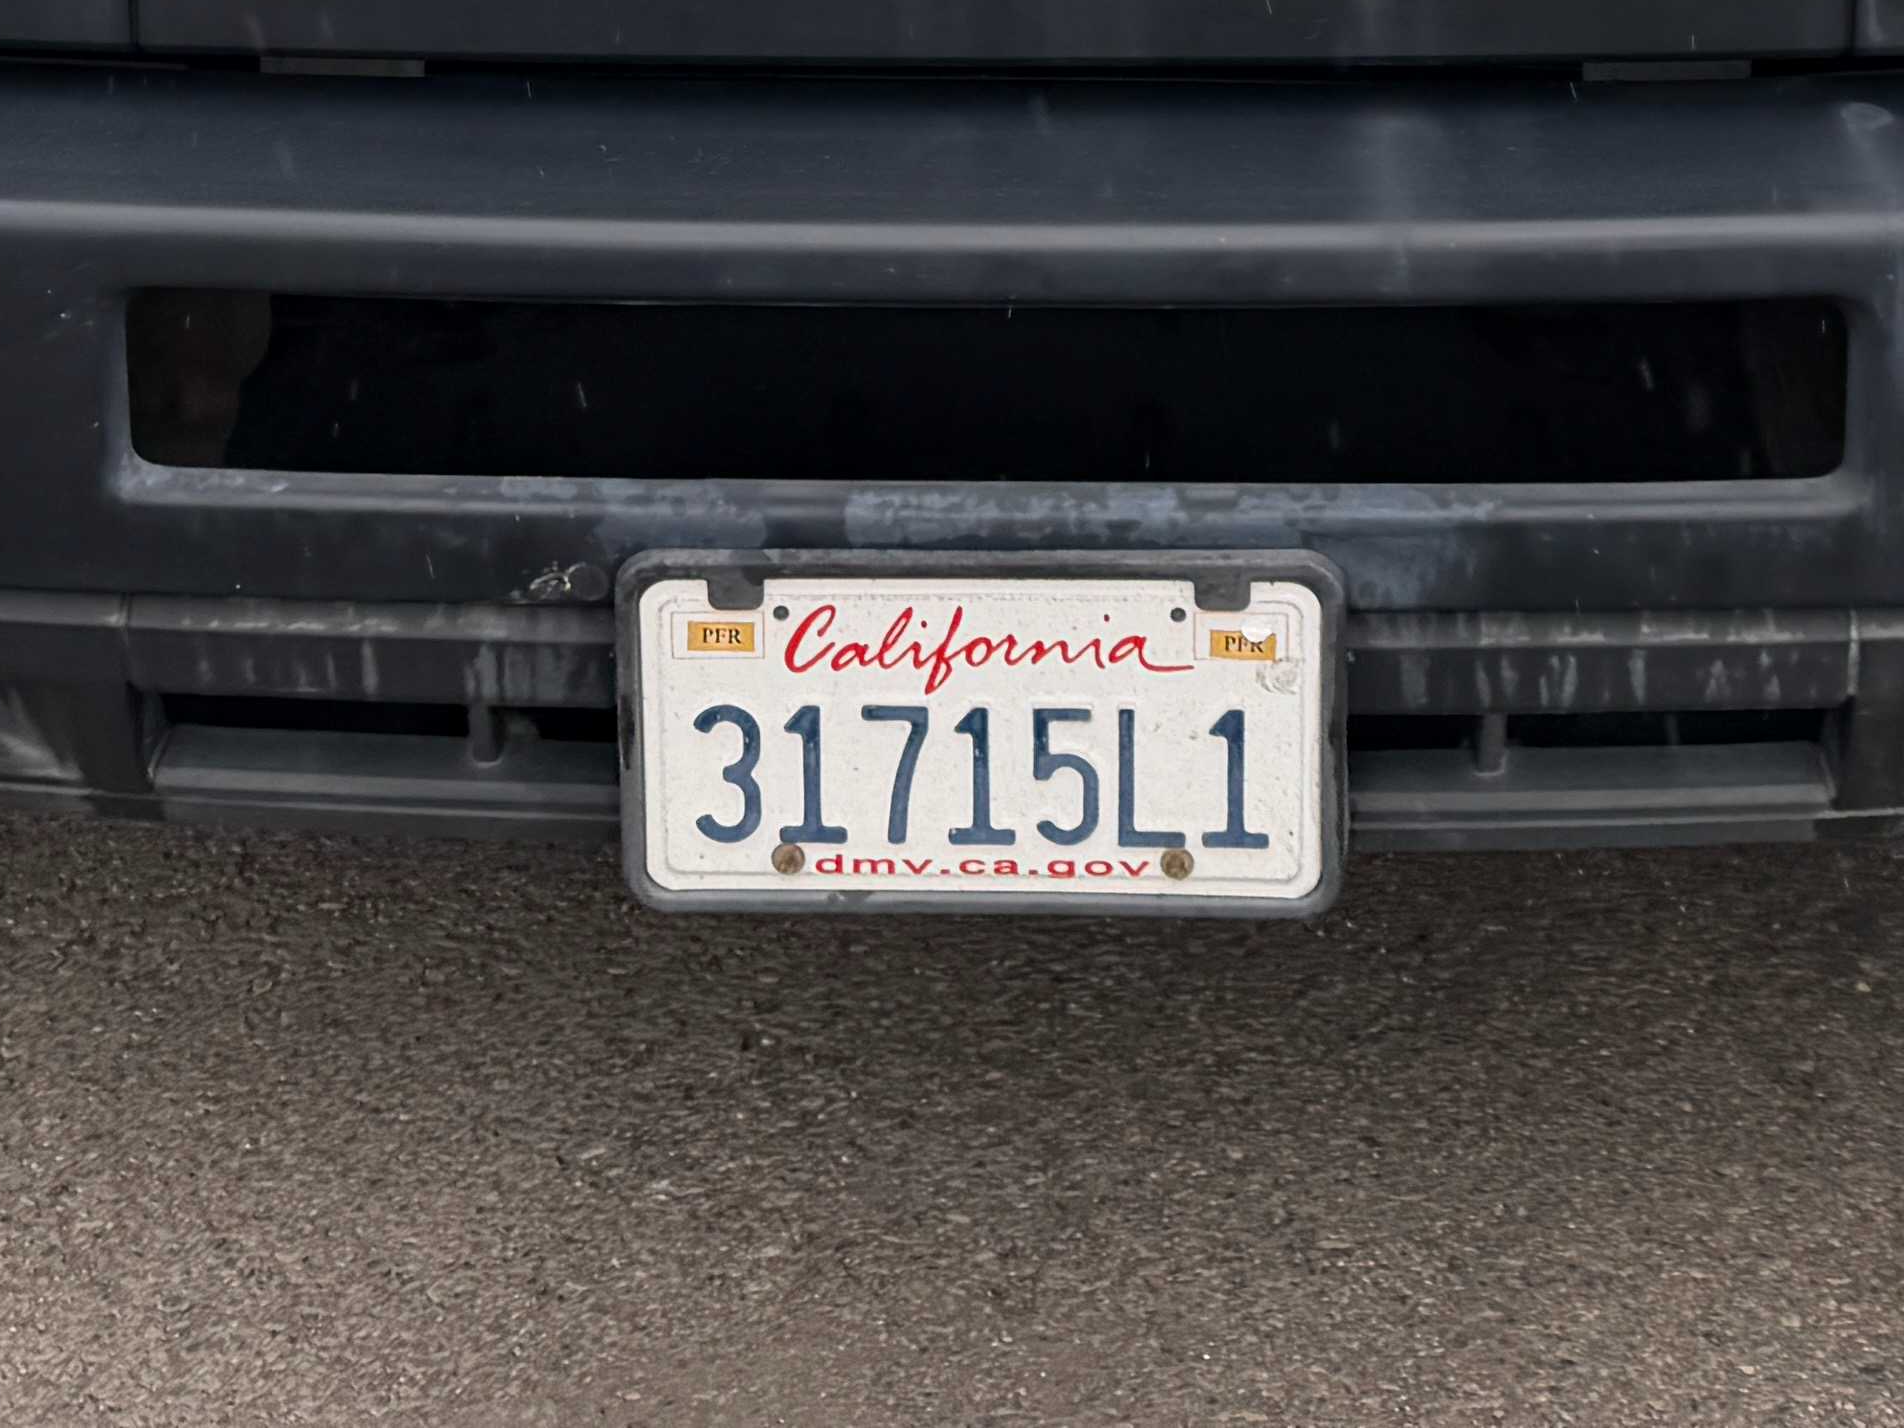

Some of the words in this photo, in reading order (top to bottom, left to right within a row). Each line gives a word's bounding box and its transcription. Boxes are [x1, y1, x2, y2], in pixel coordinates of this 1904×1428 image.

[702, 627, 742, 645] PFR
[783, 604, 1195, 696] California
[692, 704, 1271, 850] 31715L1
[814, 852, 1152, 880] dmv.ca.gov
